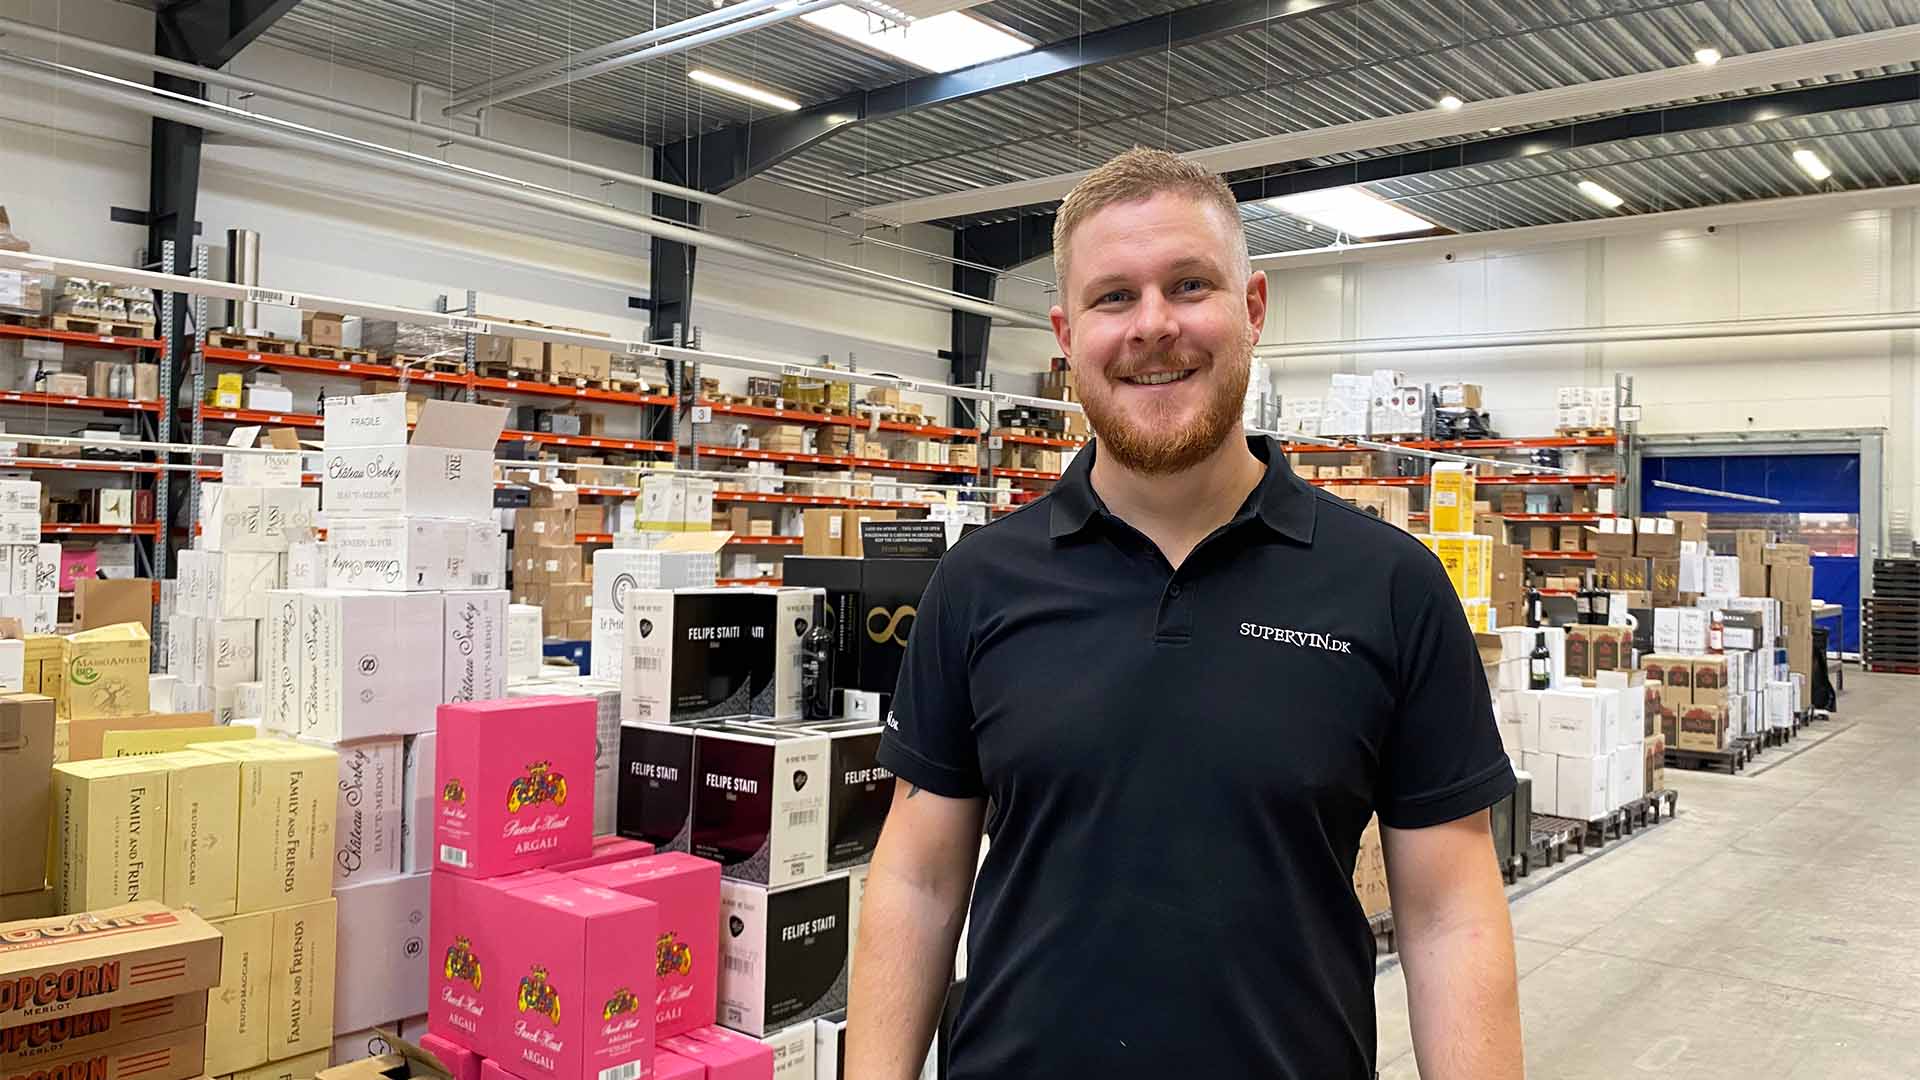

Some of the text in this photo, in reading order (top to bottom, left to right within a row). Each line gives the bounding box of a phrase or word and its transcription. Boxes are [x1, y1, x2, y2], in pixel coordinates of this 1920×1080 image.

[351, 416, 381, 427] FRAGILE
[688, 625, 740, 640] FELIPE STAITI
[1239, 622, 1351, 654] SUPERVIN.DK
[631, 761, 679, 782] FELIPE STAITI
[844, 768, 871, 785] FELIPE
[706, 772, 758, 795] FELIPE STAITI
[129, 786, 146, 835] FAMILY
[336, 748, 371, 879] Château Sorbey
[284, 770, 303, 894] FAMILY AND FRIENDS
[128, 838, 139, 860] AND
[514, 836, 558, 856] ARGALI
[781, 922, 810, 942] FELIPE
[811, 914, 836, 935] STAITI
[287, 919, 305, 1045] FAMILY AND FRIENDS
[23, 1001, 72, 1018] MERLOT
[448, 1012, 477, 1033] ARGALI
[521, 1047, 556, 1072] ARGALI
